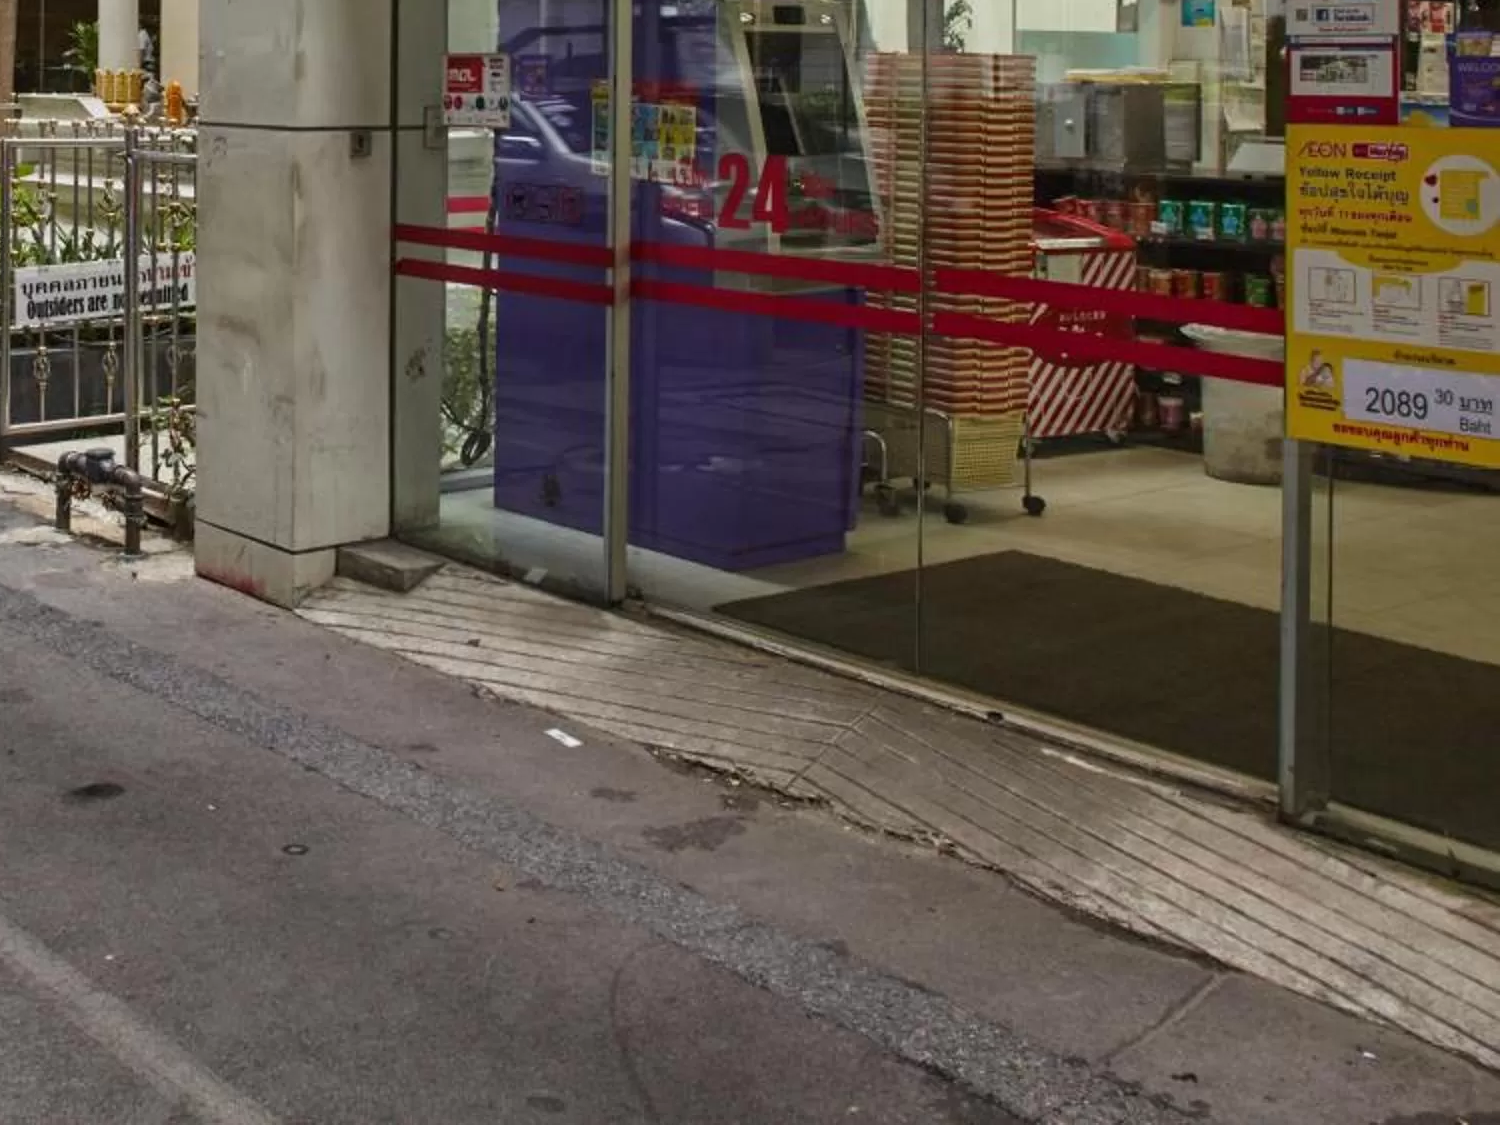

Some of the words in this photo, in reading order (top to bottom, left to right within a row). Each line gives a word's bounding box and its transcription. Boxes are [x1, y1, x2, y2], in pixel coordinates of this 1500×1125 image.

[1299, 166, 1341, 180] Yellow
[1345, 167, 1397, 183] Receipt
[718, 152, 790, 235] 24
[27, 295, 85, 319] Outsiders
[87, 293, 109, 312] are
[1364, 386, 1429, 421] 2089
[1433, 388, 1454, 406] 30
[1459, 415, 1493, 435] Baht
